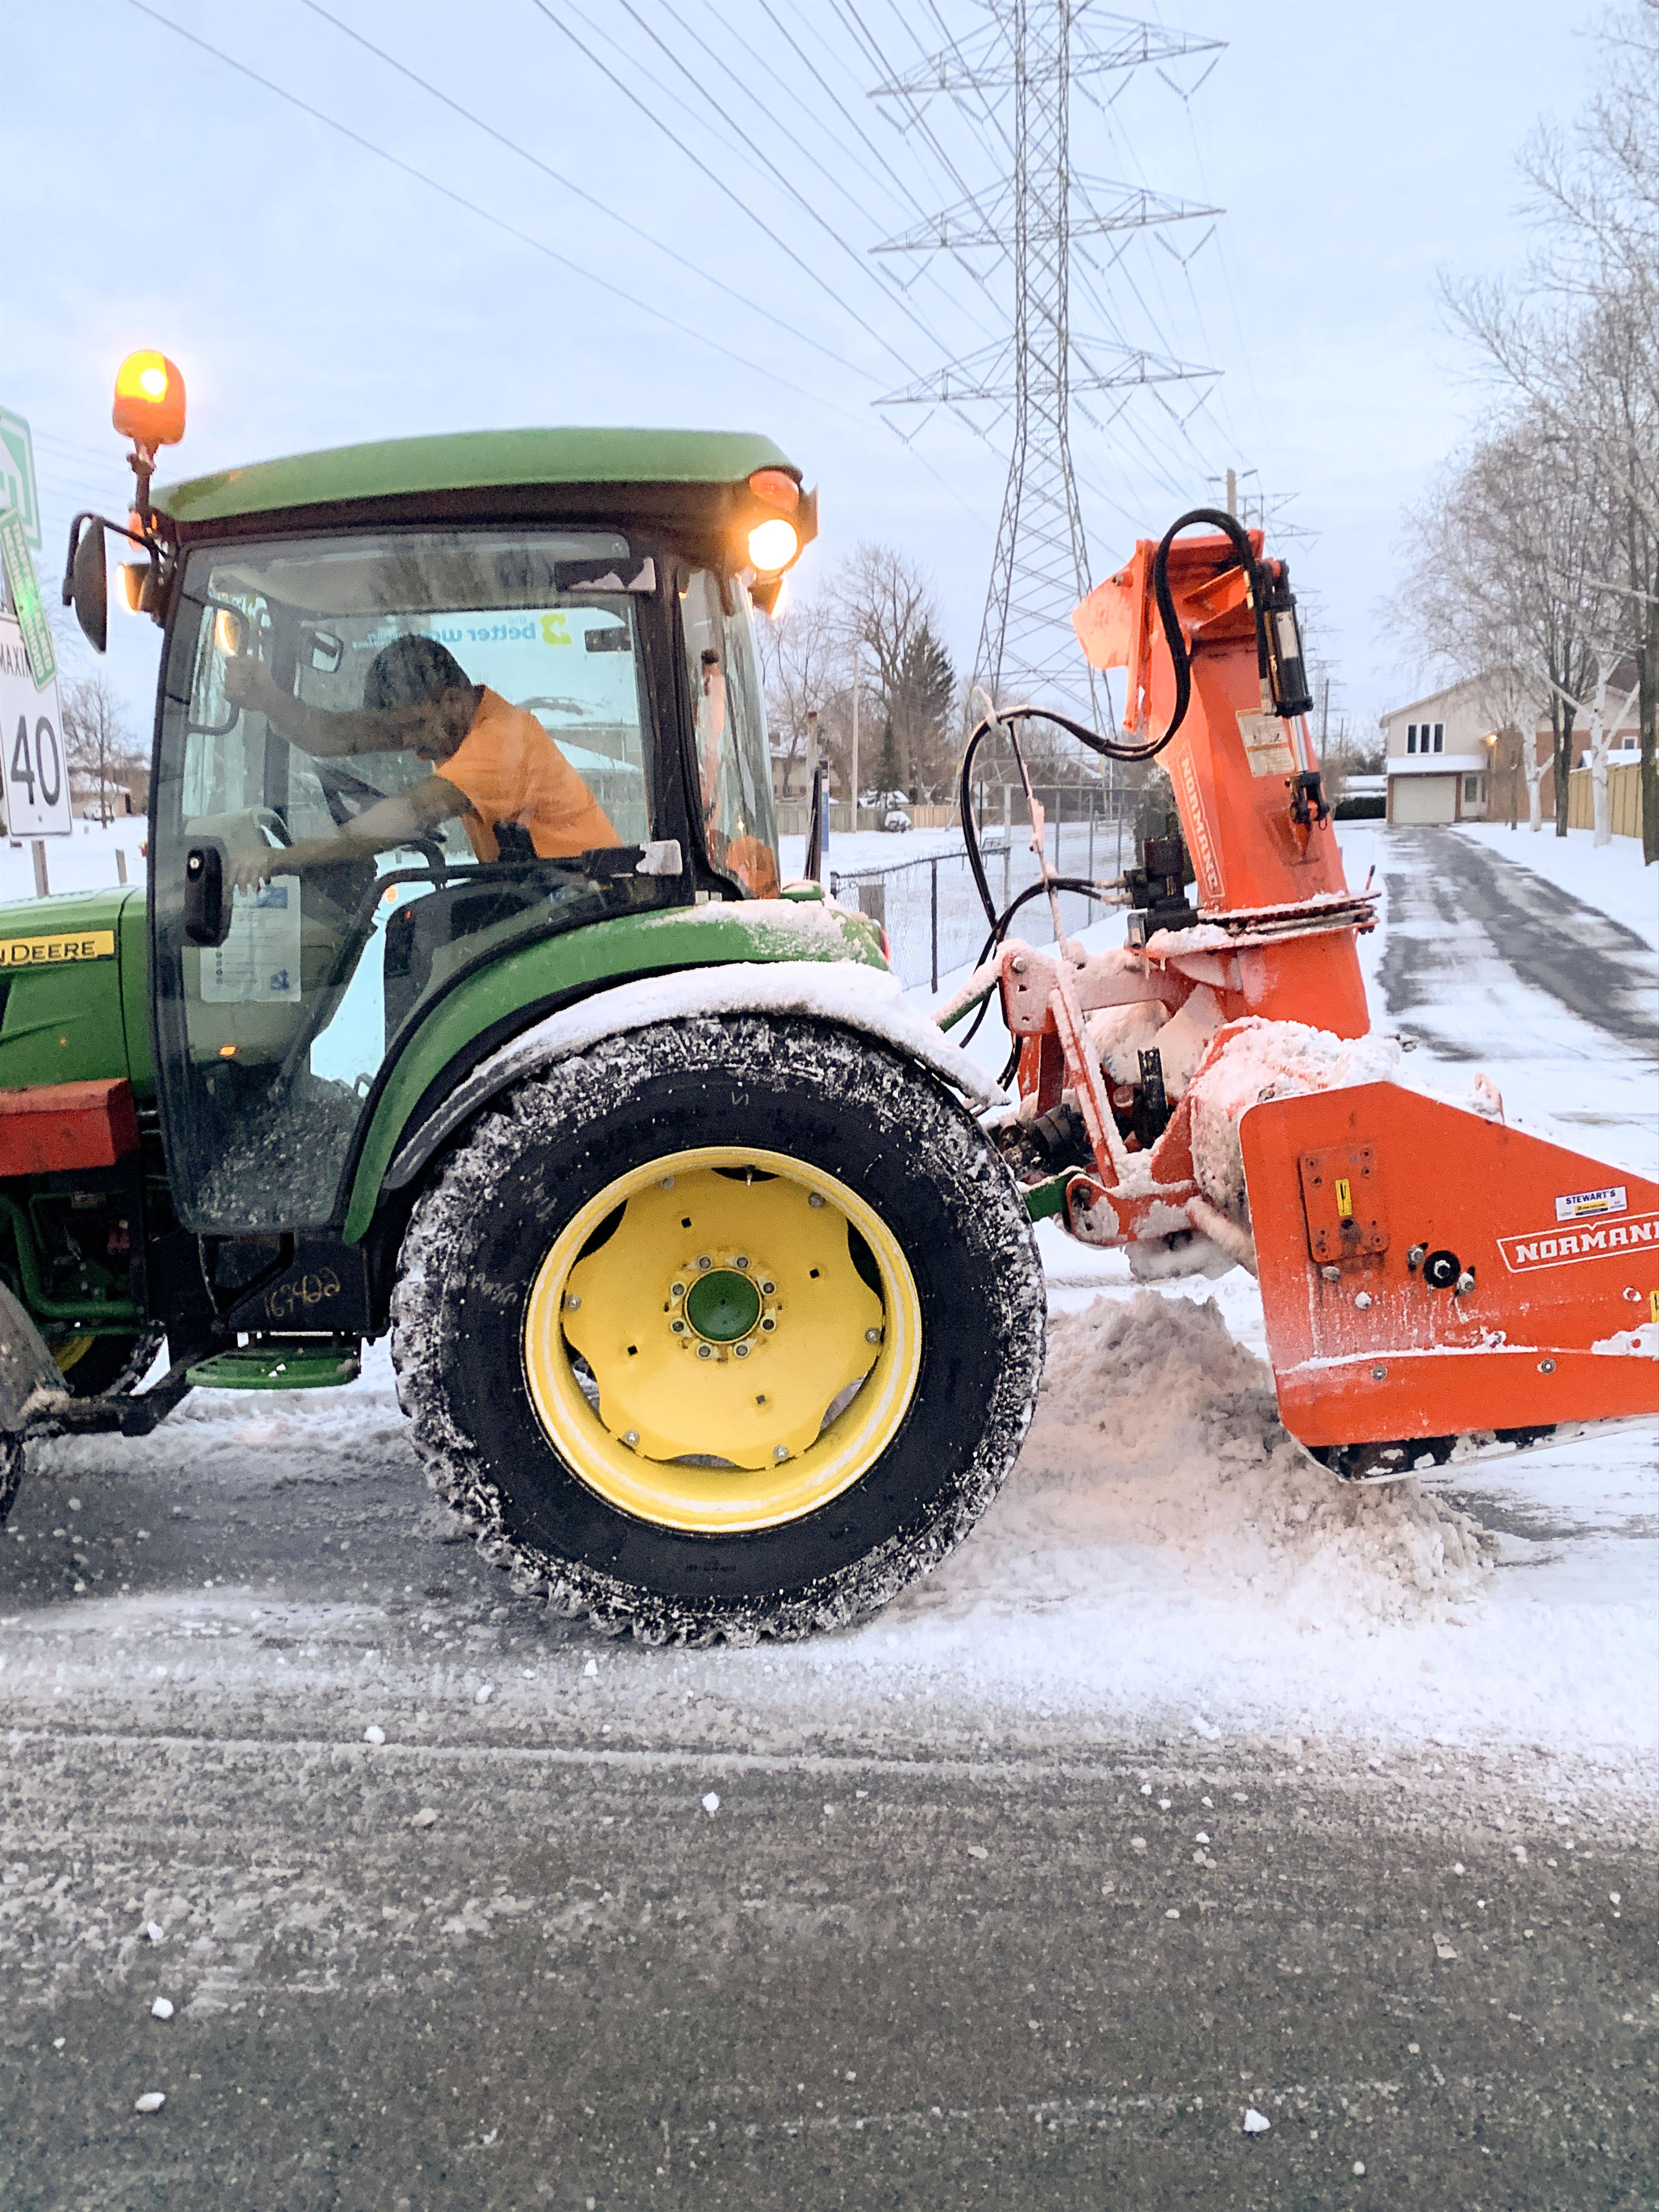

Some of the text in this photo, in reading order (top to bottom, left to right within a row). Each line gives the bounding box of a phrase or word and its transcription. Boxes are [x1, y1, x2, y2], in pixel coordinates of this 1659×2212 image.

[11, 715, 60, 807] 40
[11, 940, 95, 962] DEERE
[1566, 1189, 1616, 1205] STEWART'S
